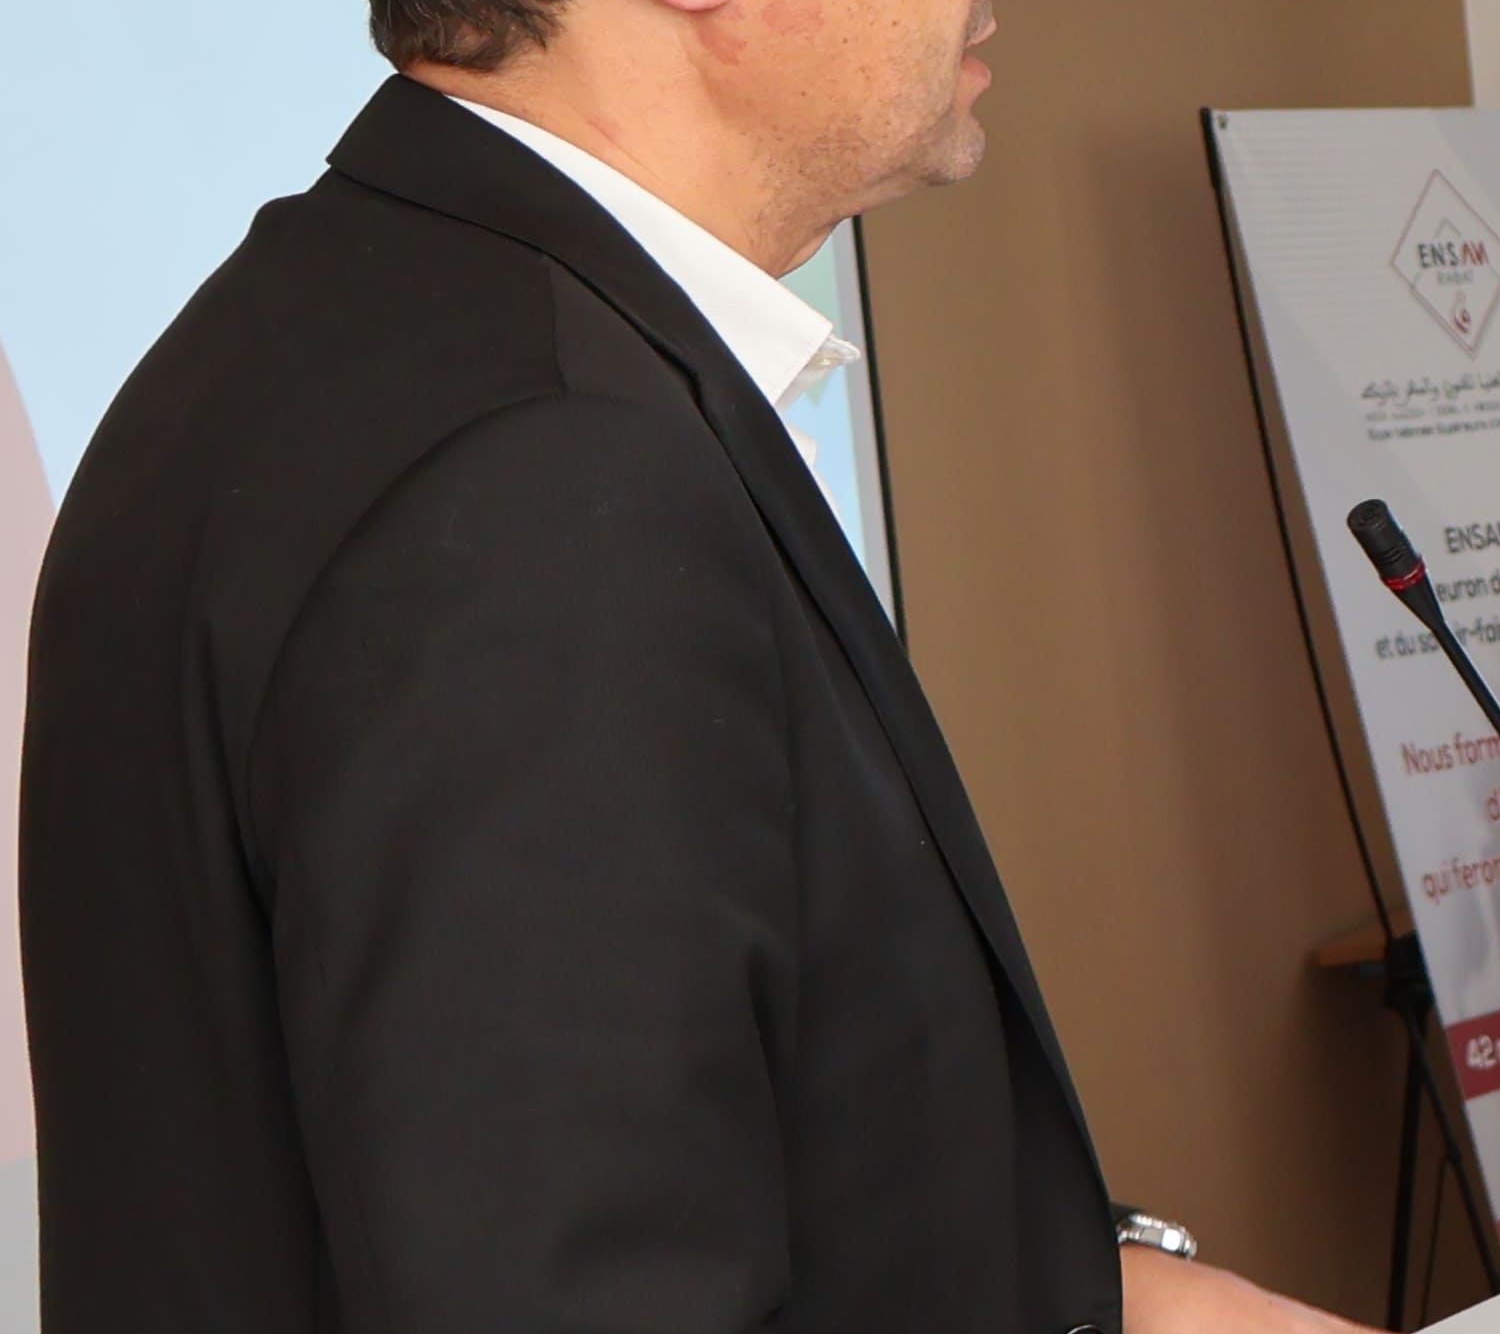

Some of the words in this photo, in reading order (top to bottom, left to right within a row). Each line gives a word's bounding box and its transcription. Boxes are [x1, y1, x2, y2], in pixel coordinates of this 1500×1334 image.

[1435, 575, 1488, 603] euron
[1376, 634, 1395, 660] et
[1395, 630, 1416, 656] du
[1401, 741, 1453, 775] Nous
[1421, 861, 1452, 906] qui
[1466, 1034, 1497, 1068] 42
